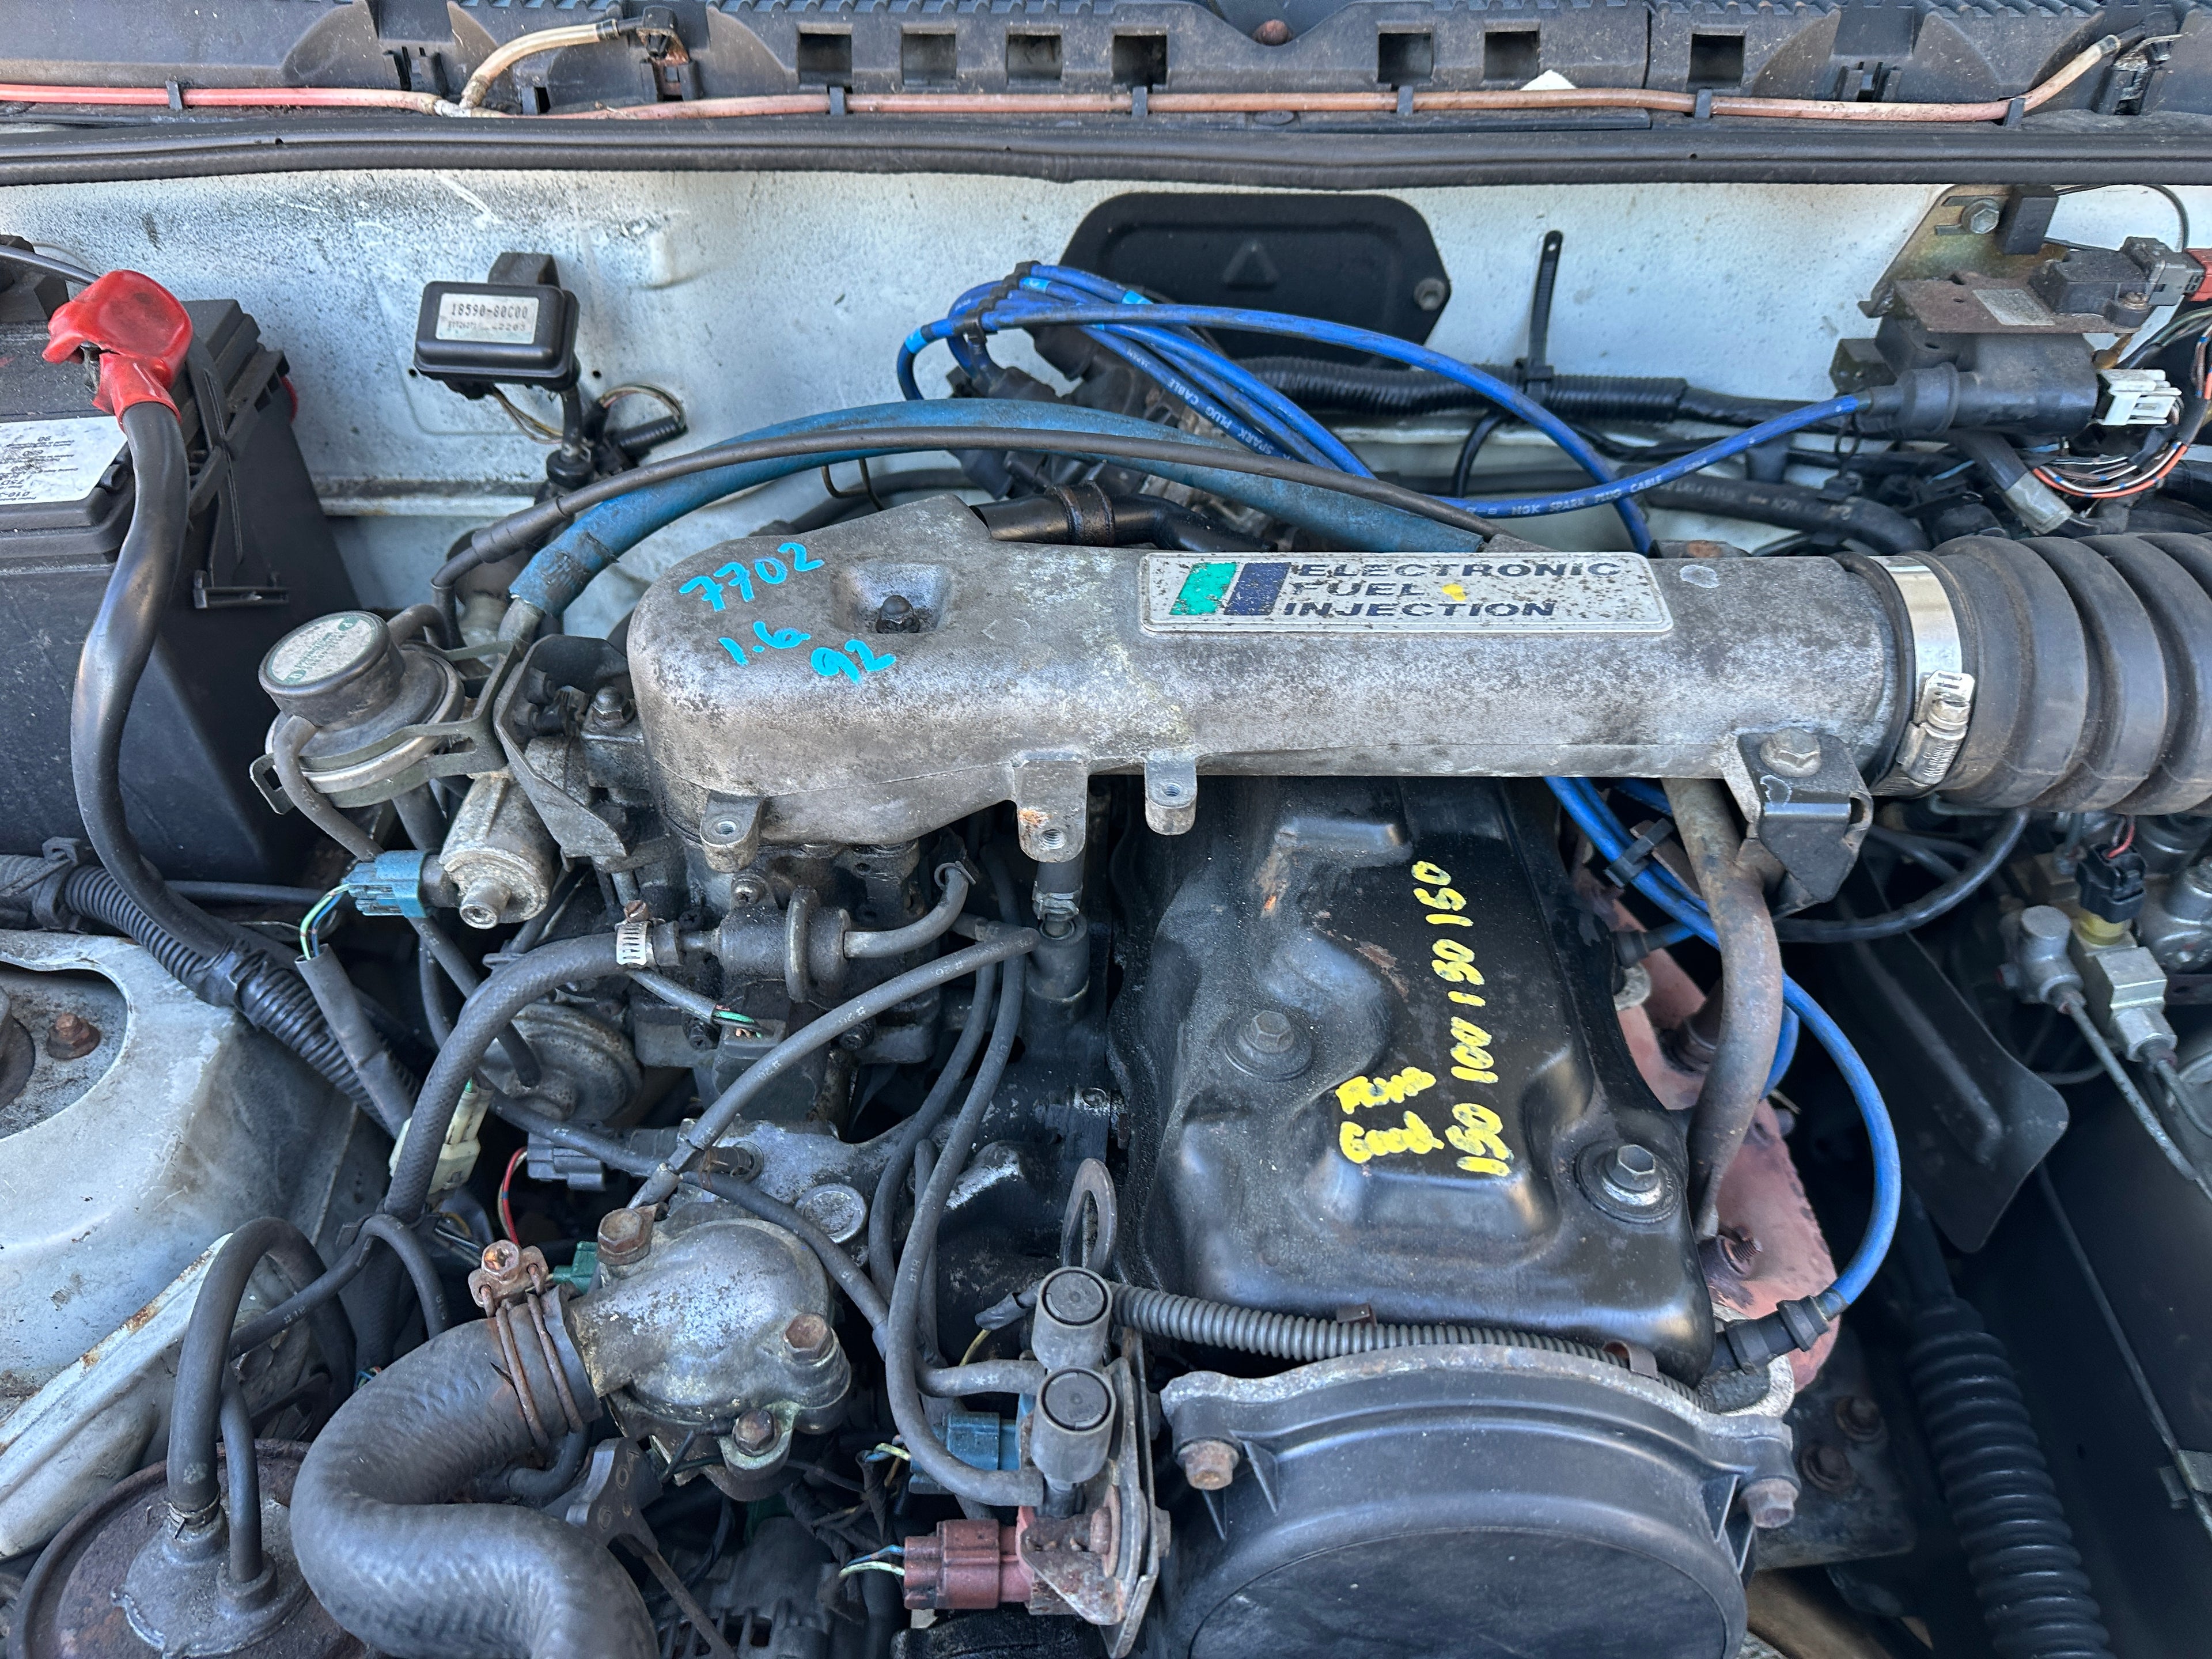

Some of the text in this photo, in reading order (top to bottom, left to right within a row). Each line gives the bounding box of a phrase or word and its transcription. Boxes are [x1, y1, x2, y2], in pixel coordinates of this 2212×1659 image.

[452, 303, 528, 319] 18590-80C00
[1166, 378, 1199, 406] CABLE
[1205, 406, 1233, 429] PLUG
[1237, 427, 1274, 455] SPARK
[1512, 503, 1541, 516] NGK
[1550, 497, 1585, 512] SPARK
[1594, 488, 1623, 503] PLUG
[1630, 475, 1663, 493] CABLE
[679, 541, 825, 612] 7702
[1298, 563, 1620, 577] ELECTRONIC
[1289, 582, 1425, 596] FUEL
[1283, 602, 1555, 616] INJECTION
[718, 620, 811, 667] 1.6
[810, 639, 896, 685] 92
